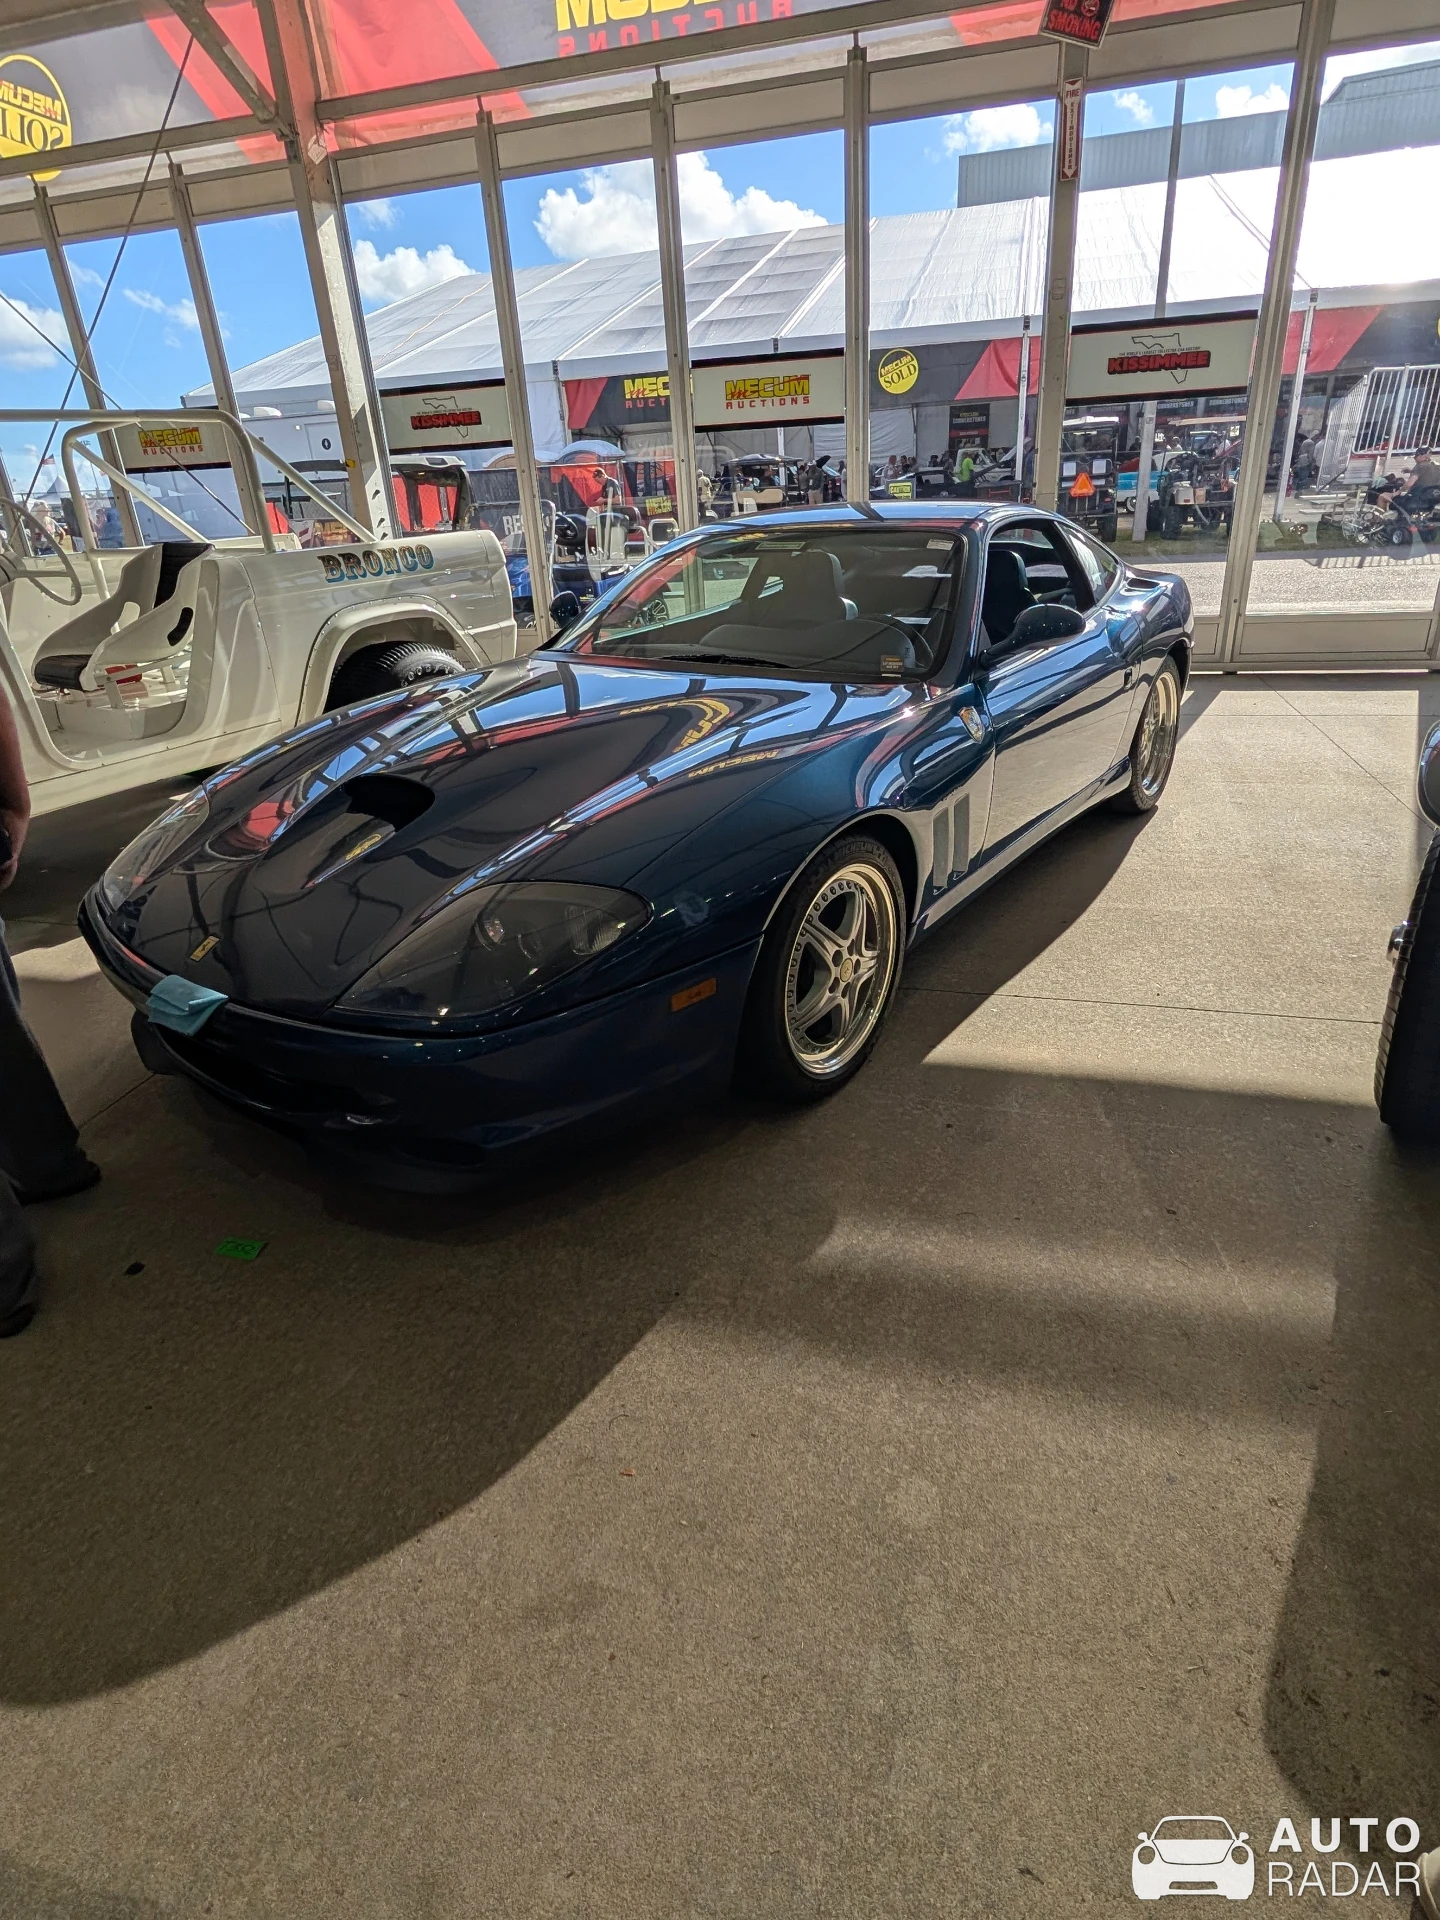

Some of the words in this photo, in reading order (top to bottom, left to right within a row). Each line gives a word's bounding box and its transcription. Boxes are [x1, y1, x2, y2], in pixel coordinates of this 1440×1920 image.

[1048, 9, 1101, 40] SMOKING
[1065, 89, 1080, 98] FIRE
[1067, 102, 1075, 170] EXTINGUISHER
[880, 354, 913, 377] MECUM
[1108, 350, 1211, 375] KISSIMMEE
[725, 374, 811, 400] MECUM
[883, 363, 917, 388] SOLD
[726, 396, 810, 410] AUCTIONS
[410, 411, 482, 430] KISSIMMEE
[138, 427, 202, 448] MECUM
[143, 445, 204, 456] AUCTIONS
[317, 543, 434, 583] BRONCO
